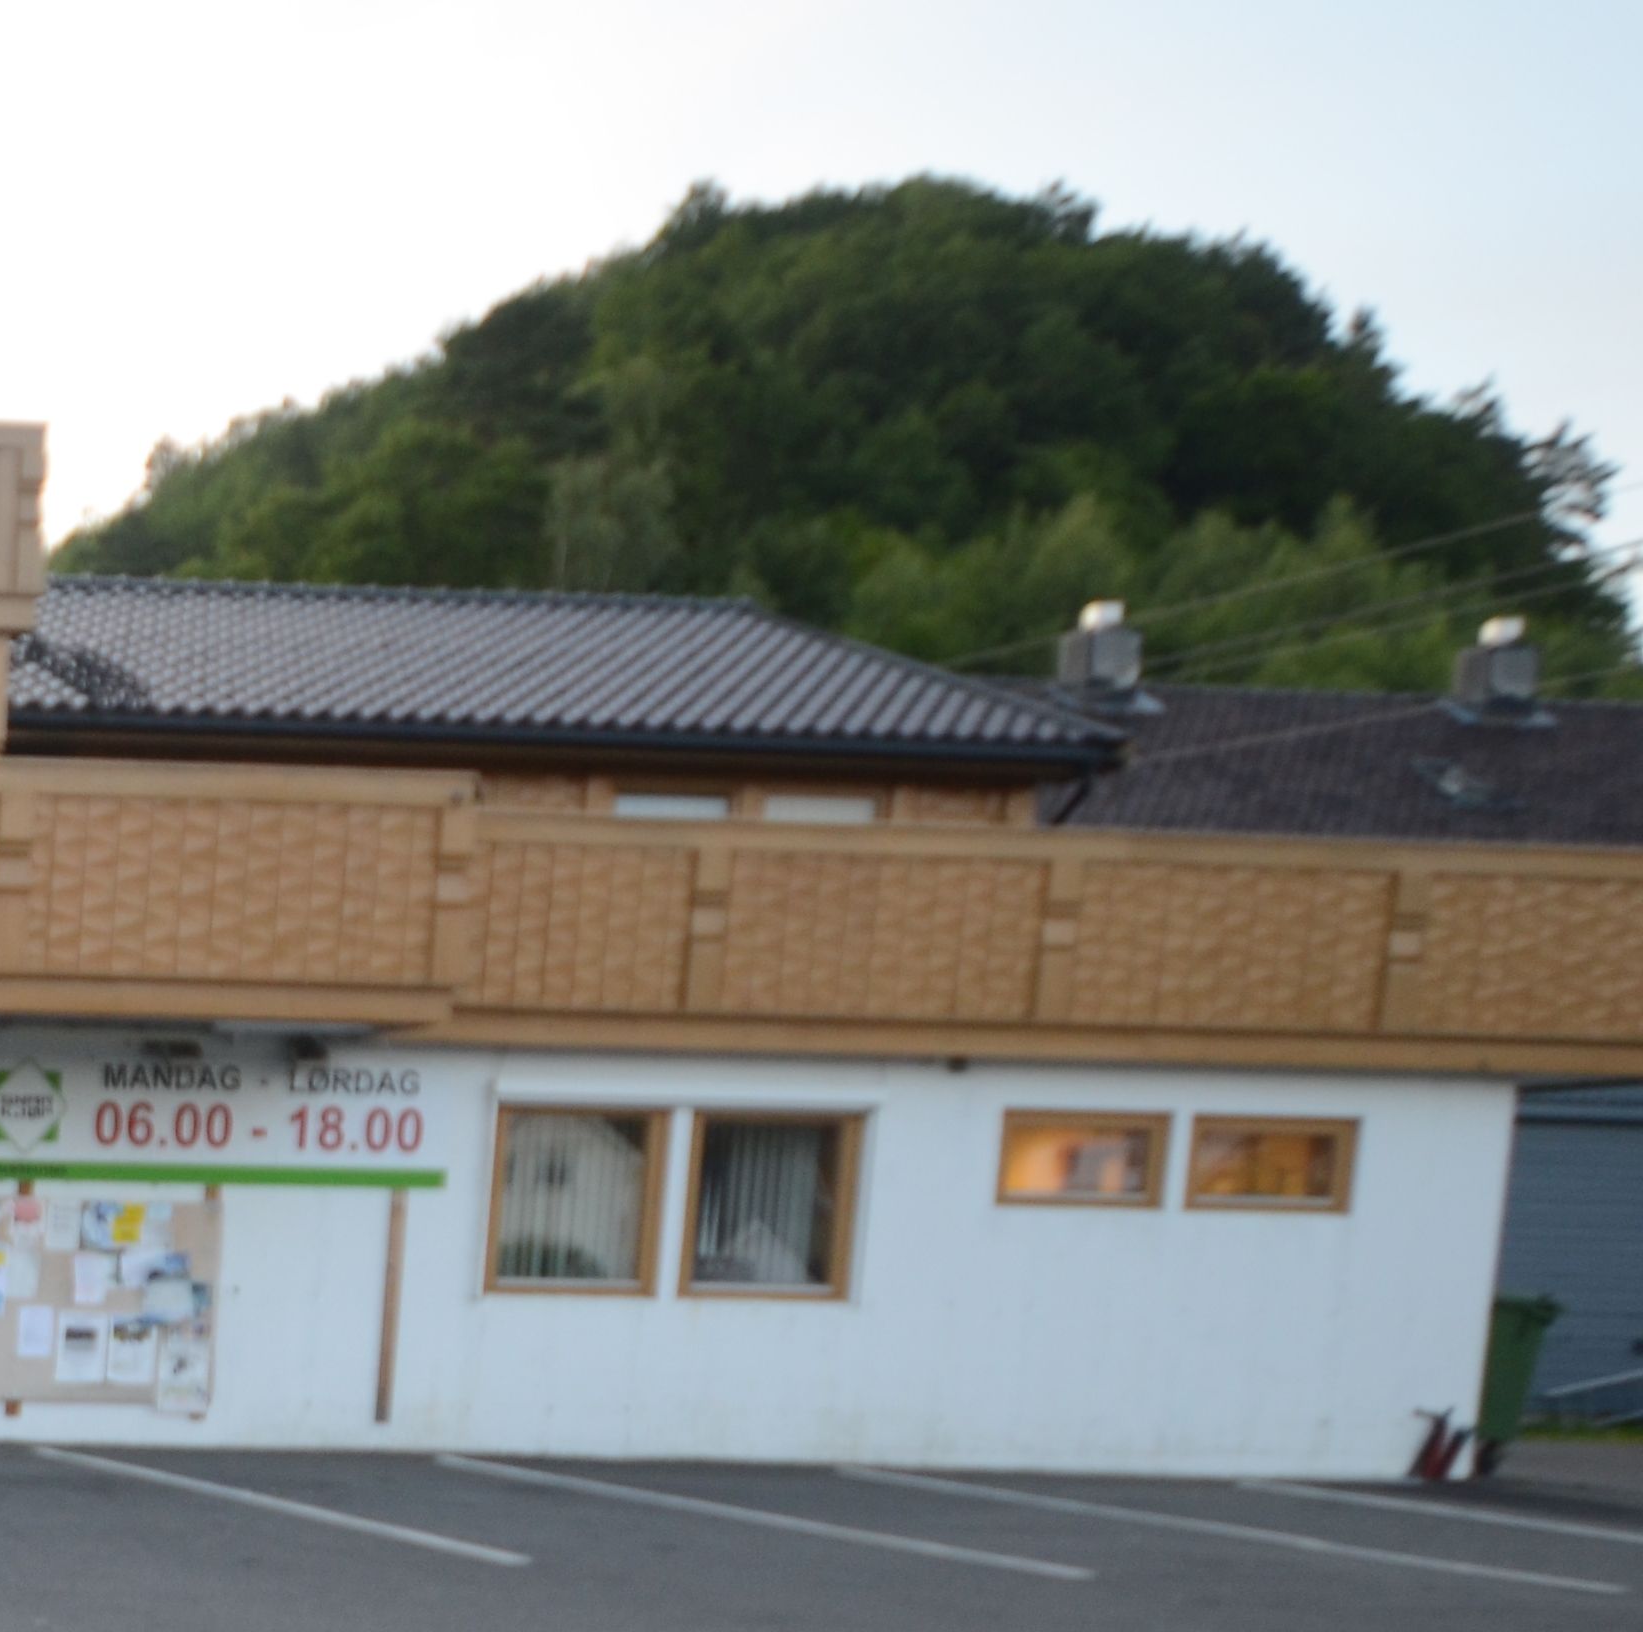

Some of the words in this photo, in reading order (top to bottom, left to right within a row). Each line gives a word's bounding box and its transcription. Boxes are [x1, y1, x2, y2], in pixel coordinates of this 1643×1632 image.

[103, 1062, 242, 1092] MANDAG
[288, 1066, 422, 1095] LØRDAG
[94, 1101, 234, 1148] 06.00
[289, 1105, 425, 1152] 18.00
